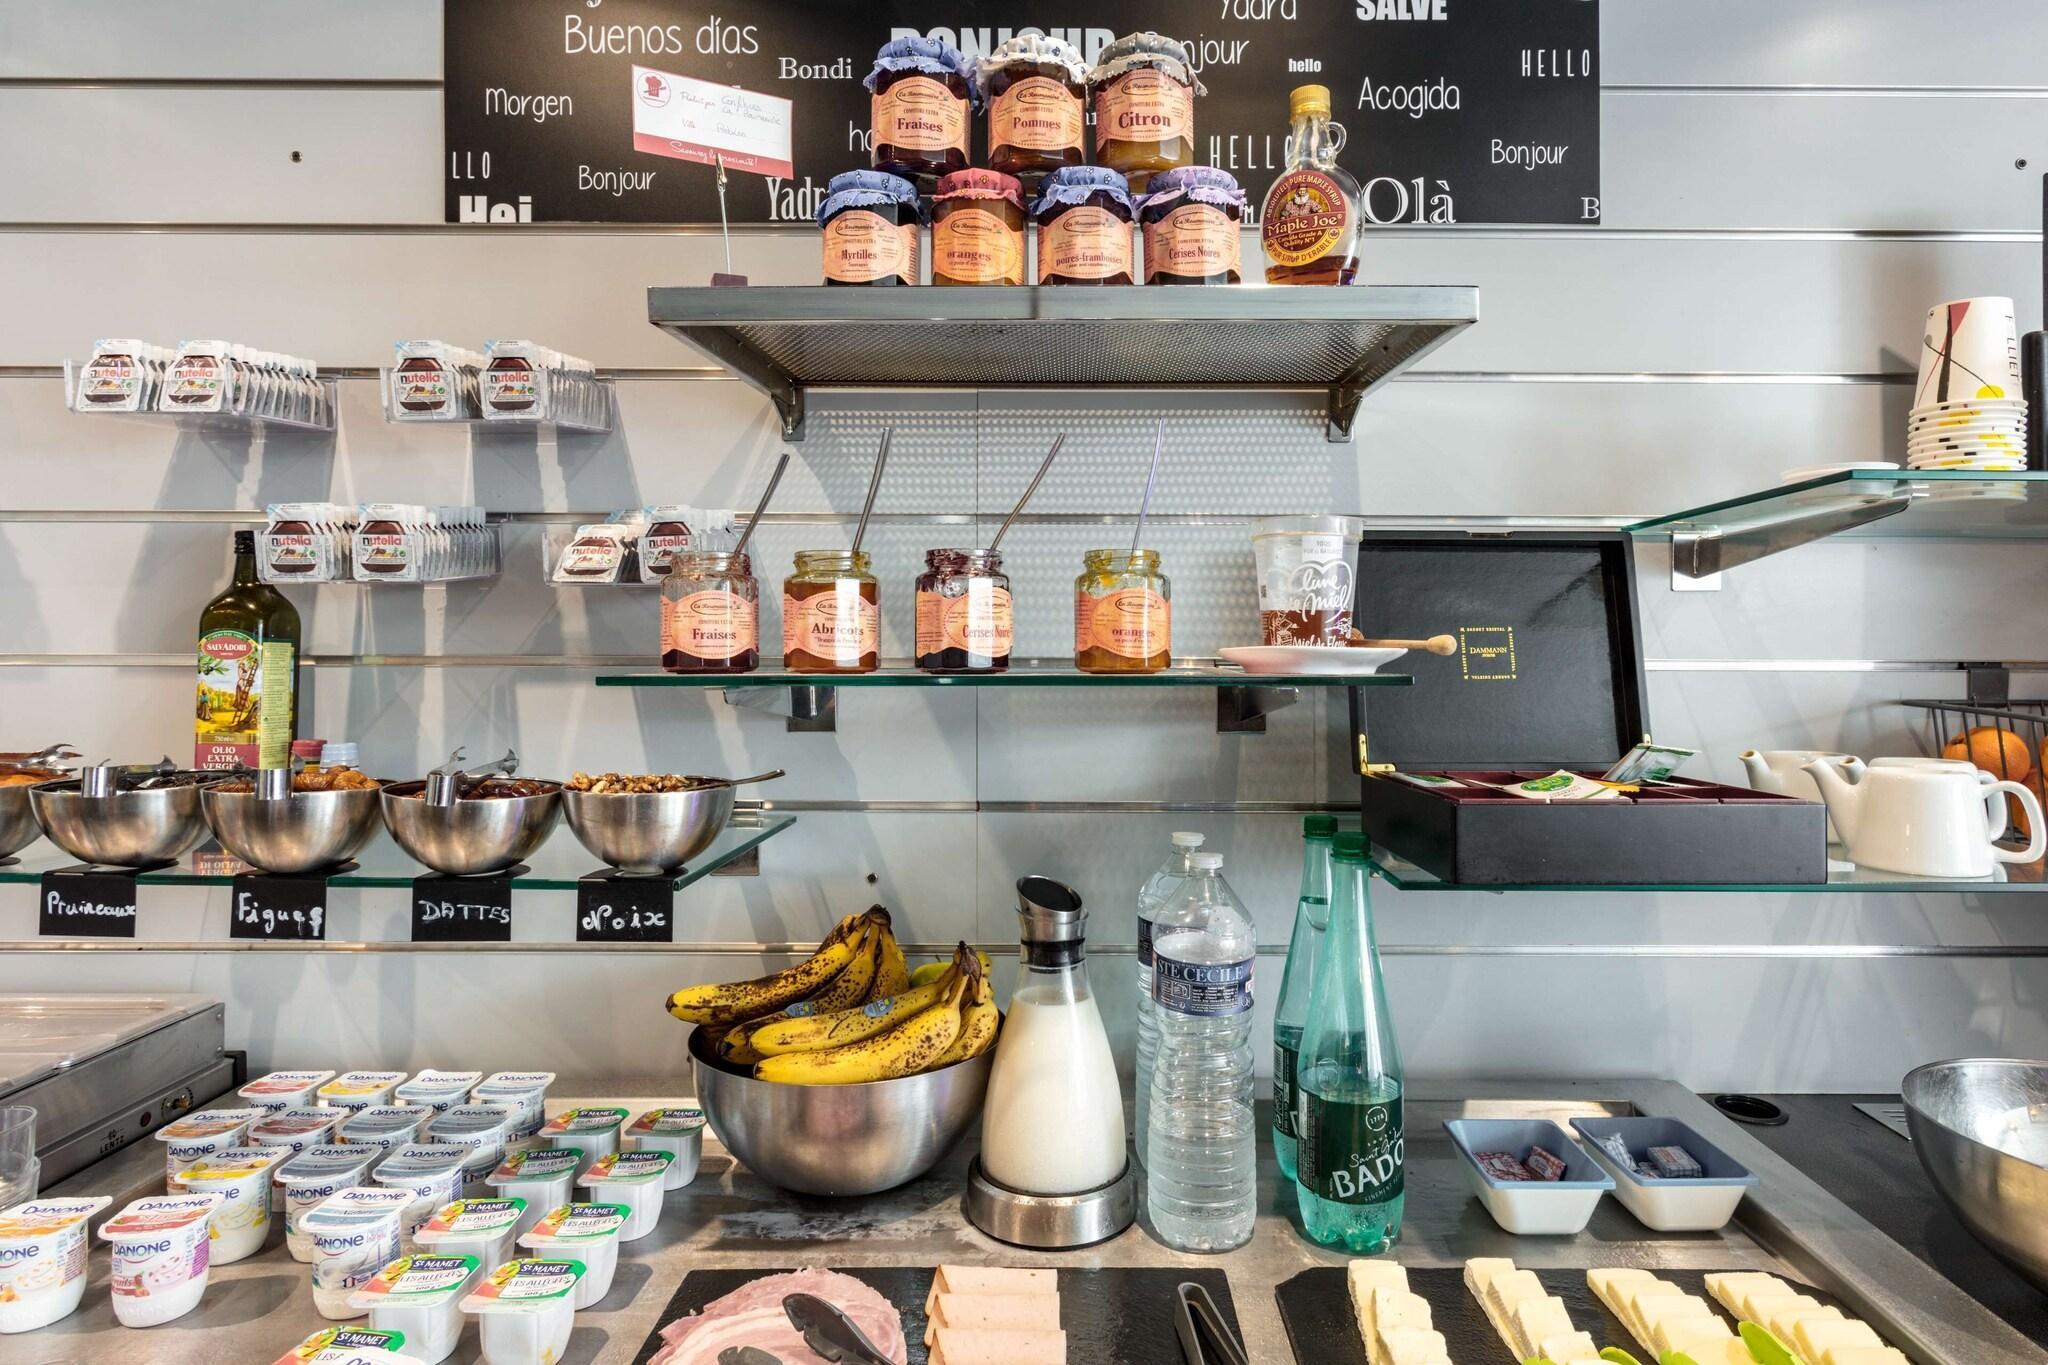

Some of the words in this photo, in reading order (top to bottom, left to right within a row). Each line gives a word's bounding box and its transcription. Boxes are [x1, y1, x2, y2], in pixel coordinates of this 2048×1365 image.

[565, 14, 682, 54] Buenos
[696, 15, 759, 54] días
[778, 57, 853, 79] Bondi
[1288, 59, 1322, 73] hello
[1521, 49, 1591, 77] HELLO
[1358, 76, 1460, 119] Acogida
[485, 87, 573, 123] Morgen
[897, 117, 943, 133] Fraises
[1013, 117, 1062, 130] Pommes
[1118, 112, 1171, 128] Citron
[1490, 139, 1569, 170] Bonjour
[578, 165, 657, 196] Bonjour
[765, 176, 829, 220] Yadr
[1266, 183, 1289, 218] ABSOLUTELY
[1289, 174, 1307, 185] PURE
[1306, 174, 1328, 190] MAPLE
[1325, 185, 1342, 206] SYRUP
[1363, 176, 1457, 224] Olà
[1579, 196, 1600, 219] B
[1267, 218, 1308, 237] Maple
[1311, 215, 1338, 228] Joe
[841, 249, 878, 260] Myrtilles
[947, 250, 991, 263] oranges
[1056, 251, 1123, 265] poires-framboises
[1169, 248, 1193, 260] Cerises
[1197, 247, 1221, 259] Noires
[174, 366, 214, 379] nutella
[400, 373, 441, 384] nutella
[490, 373, 530, 384] nutella
[271, 535, 312, 547] nutella
[362, 535, 402, 547] nutella
[648, 536, 689, 548] nutella
[571, 546, 612, 556] nutella
[692, 628, 737, 640] Fraises
[811, 622, 865, 635] Abricots
[962, 624, 994, 639] Cerises
[207, 643, 247, 651] SALVADORI
[212, 746, 236, 754] OLIO
[207, 754, 239, 762] EXTRA
[418, 900, 510, 925] DATTES
[1158, 959, 1180, 979] STE
[1183, 966, 1244, 983] CECILE
[168, 1143, 216, 1157] DANONE
[216, 1151, 279, 1159] DANONE
[311, 1148, 373, 1156] DANONE
[402, 1149, 464, 1159] DANONE
[538, 1151, 568, 1159] MAMET
[288, 1185, 334, 1199] DANONE
[342, 1191, 407, 1200] DANONE
[21, 1204, 95, 1215] DANONE
[138, 1198, 213, 1211] DANONE
[476, 1202, 512, 1210] MAMET
[114, 1239, 171, 1256] DANONE
[314, 1234, 364, 1248] DANONE
[424, 1259, 463, 1267] MAMET
[531, 1265, 569, 1273] MAMET
[348, 1333, 388, 1345] MAMET
